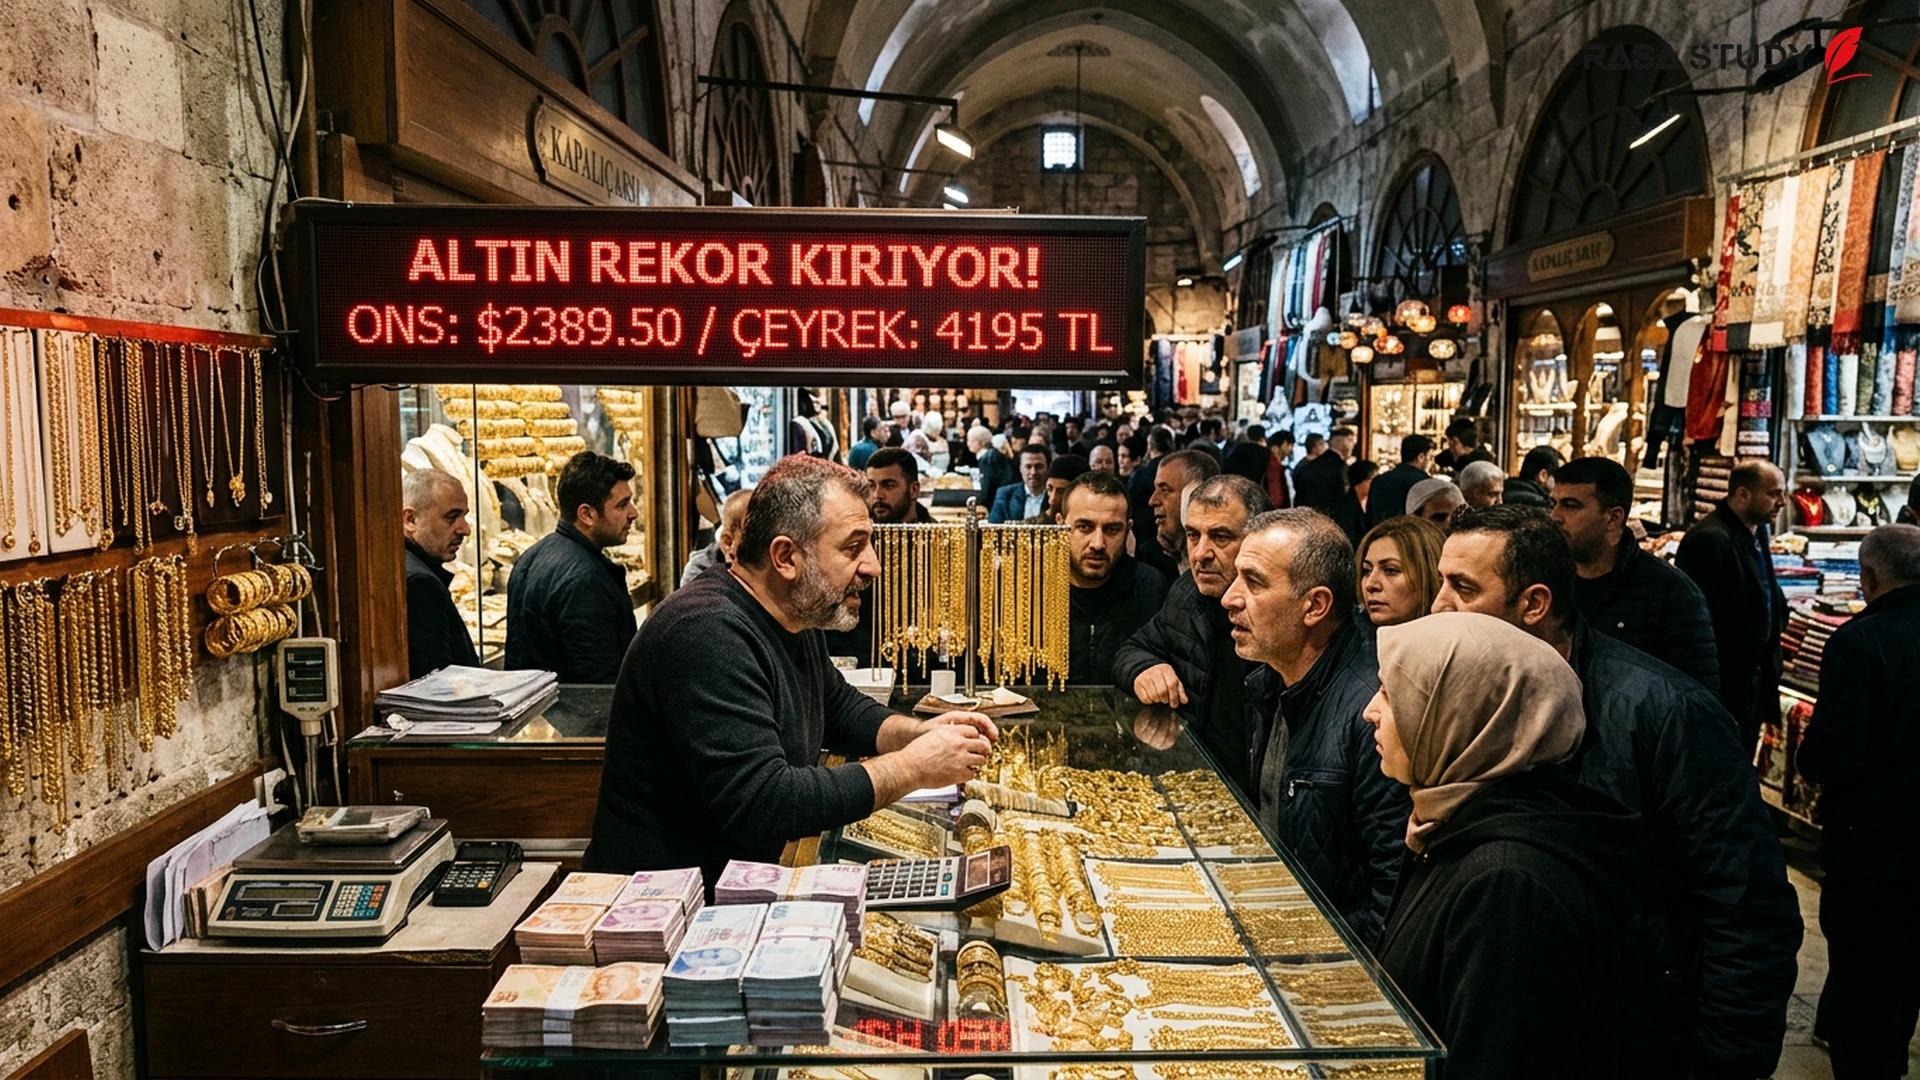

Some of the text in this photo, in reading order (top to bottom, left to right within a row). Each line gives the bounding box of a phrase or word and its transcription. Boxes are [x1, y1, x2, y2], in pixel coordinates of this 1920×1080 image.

[408, 238, 1041, 290] ALTIN REKOR KIRIYOR!
[347, 303, 1114, 357] ONS: $2389.50 / ÇEYREK: 4195 TL
